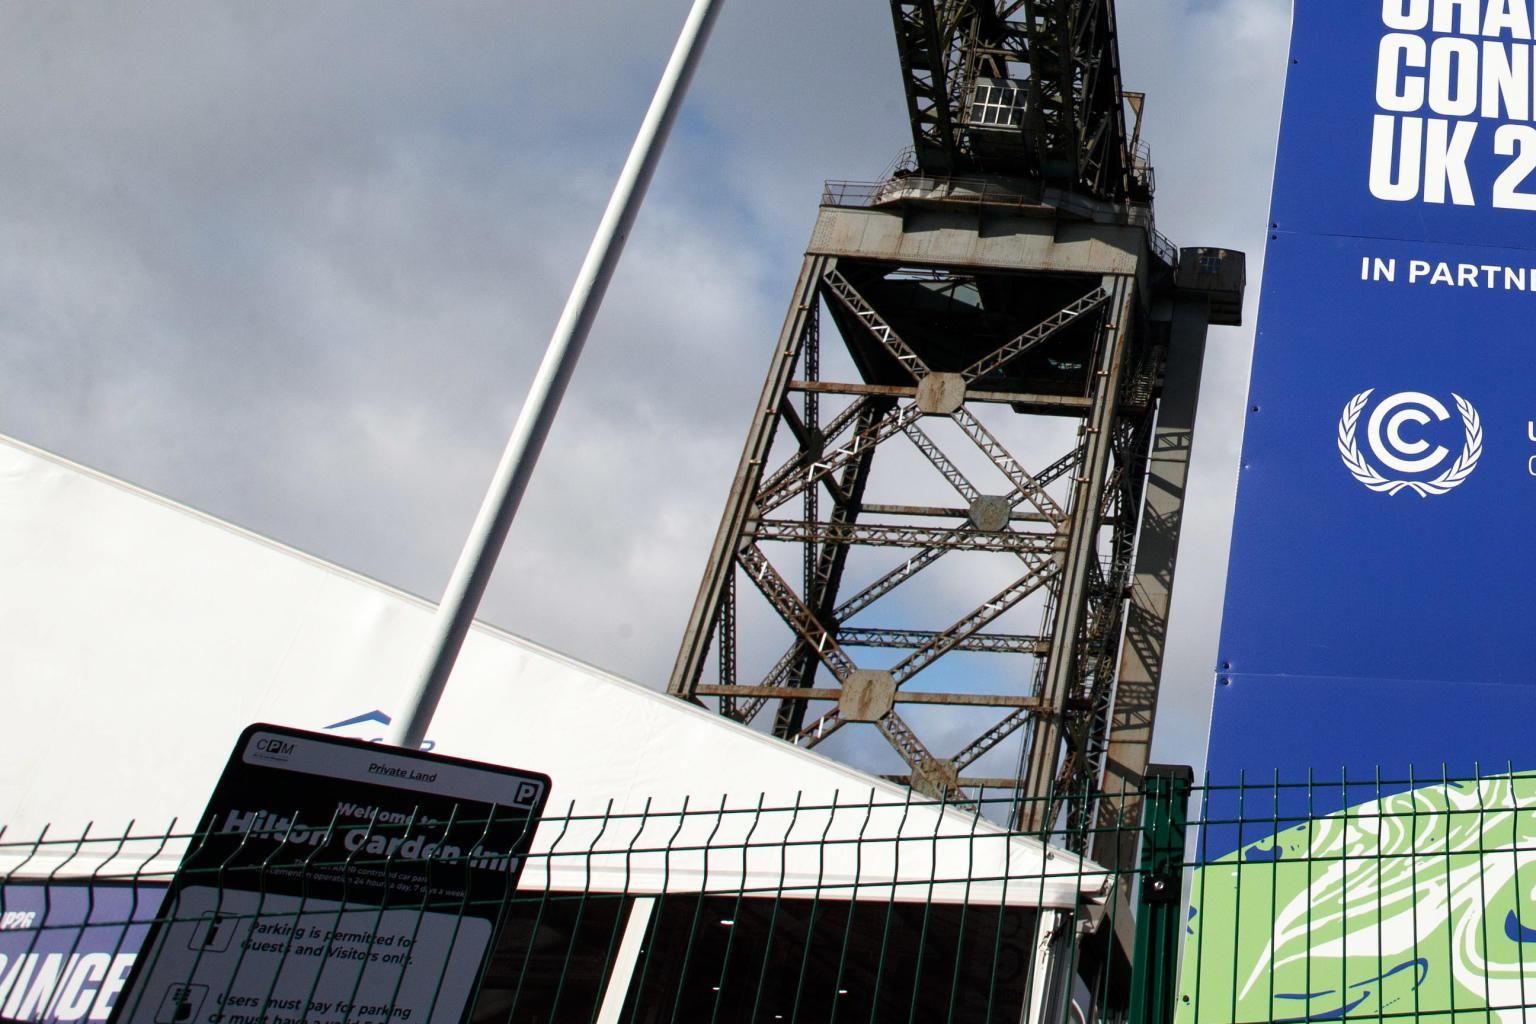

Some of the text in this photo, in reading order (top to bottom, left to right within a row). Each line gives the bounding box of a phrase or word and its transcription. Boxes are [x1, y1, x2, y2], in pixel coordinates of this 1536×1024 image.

[1369, 115, 1478, 206] UK
[1362, 257, 1396, 282] IN
[256, 738, 295, 755] CPM
[368, 762, 437, 783] Private Land
[337, 801, 439, 829] Welcome to
[222, 808, 520, 873] Hilton Garden Inn
[1, 912, 36, 930] P26
[249, 921, 305, 940] Parking
[309, 926, 321, 939] is
[398, 936, 416, 948] for
[241, 939, 291, 953] Guests
[295, 943, 323, 957] and
[326, 946, 380, 961] Visitors
[217, 993, 412, 1020] Users must pay for parking
